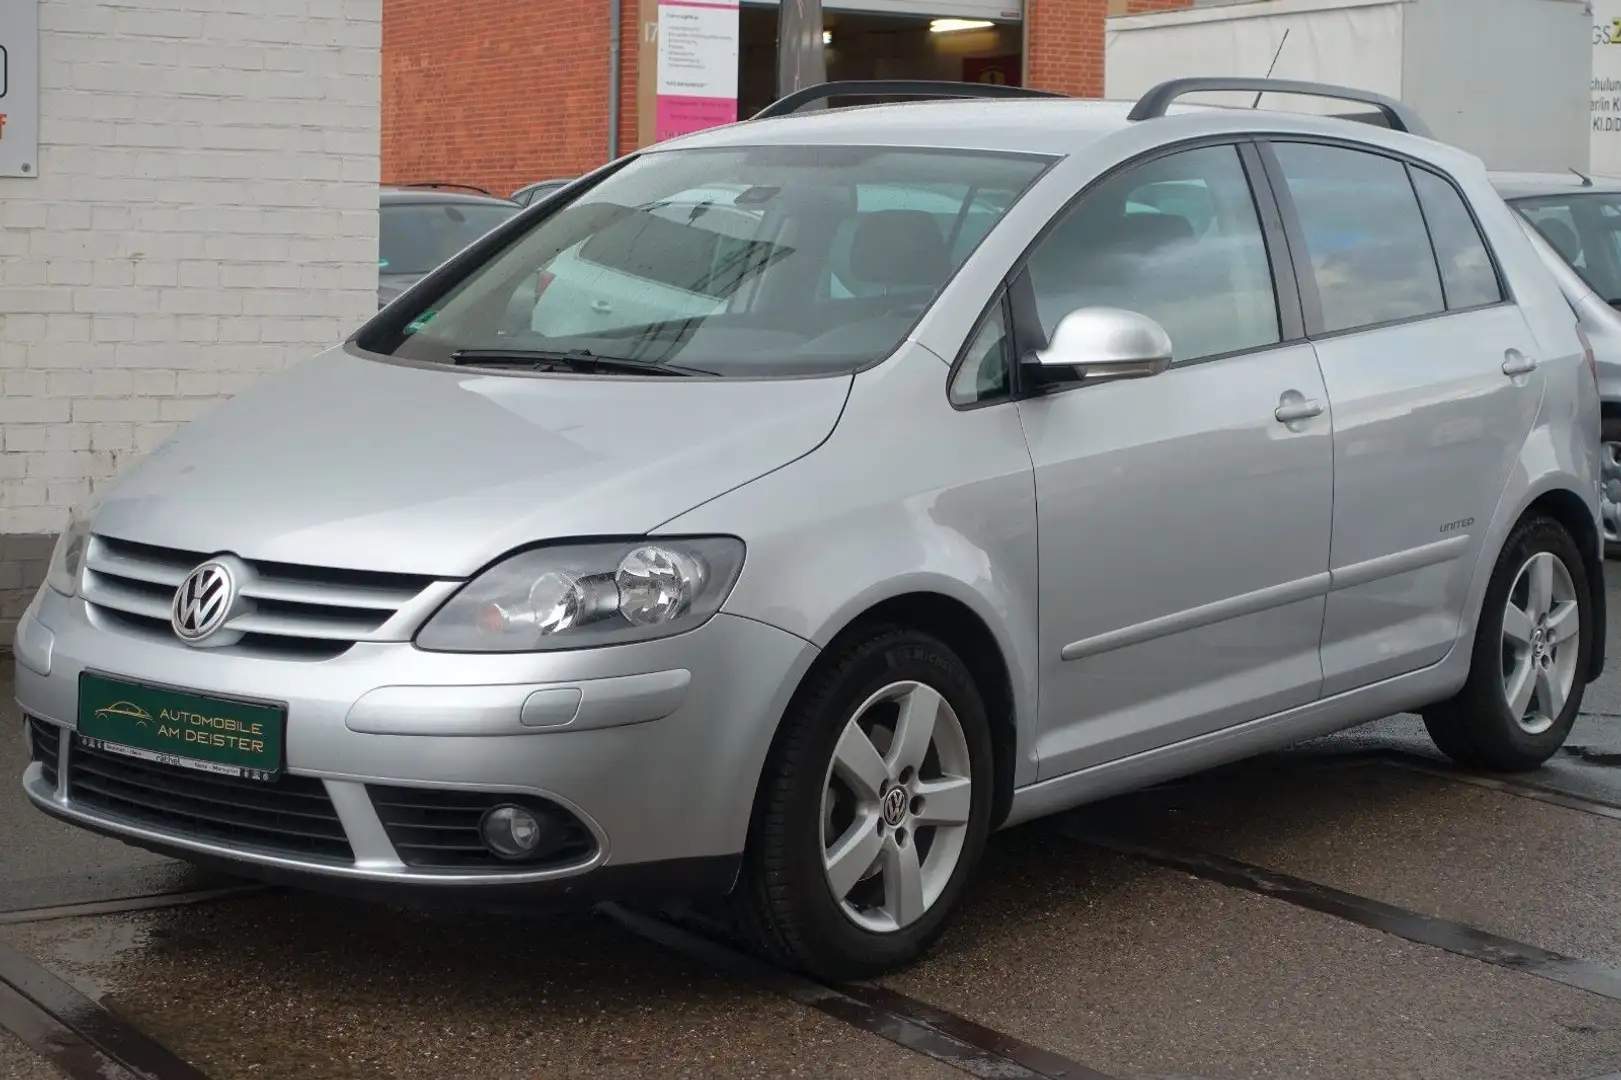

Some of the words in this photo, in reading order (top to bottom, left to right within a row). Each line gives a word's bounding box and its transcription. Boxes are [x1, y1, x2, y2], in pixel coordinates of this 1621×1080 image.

[1439, 517, 1475, 533] UNITED
[159, 708, 263, 736] AUTOMOBILE
[157, 724, 180, 739] AM
[185, 729, 264, 753] DEISTER
